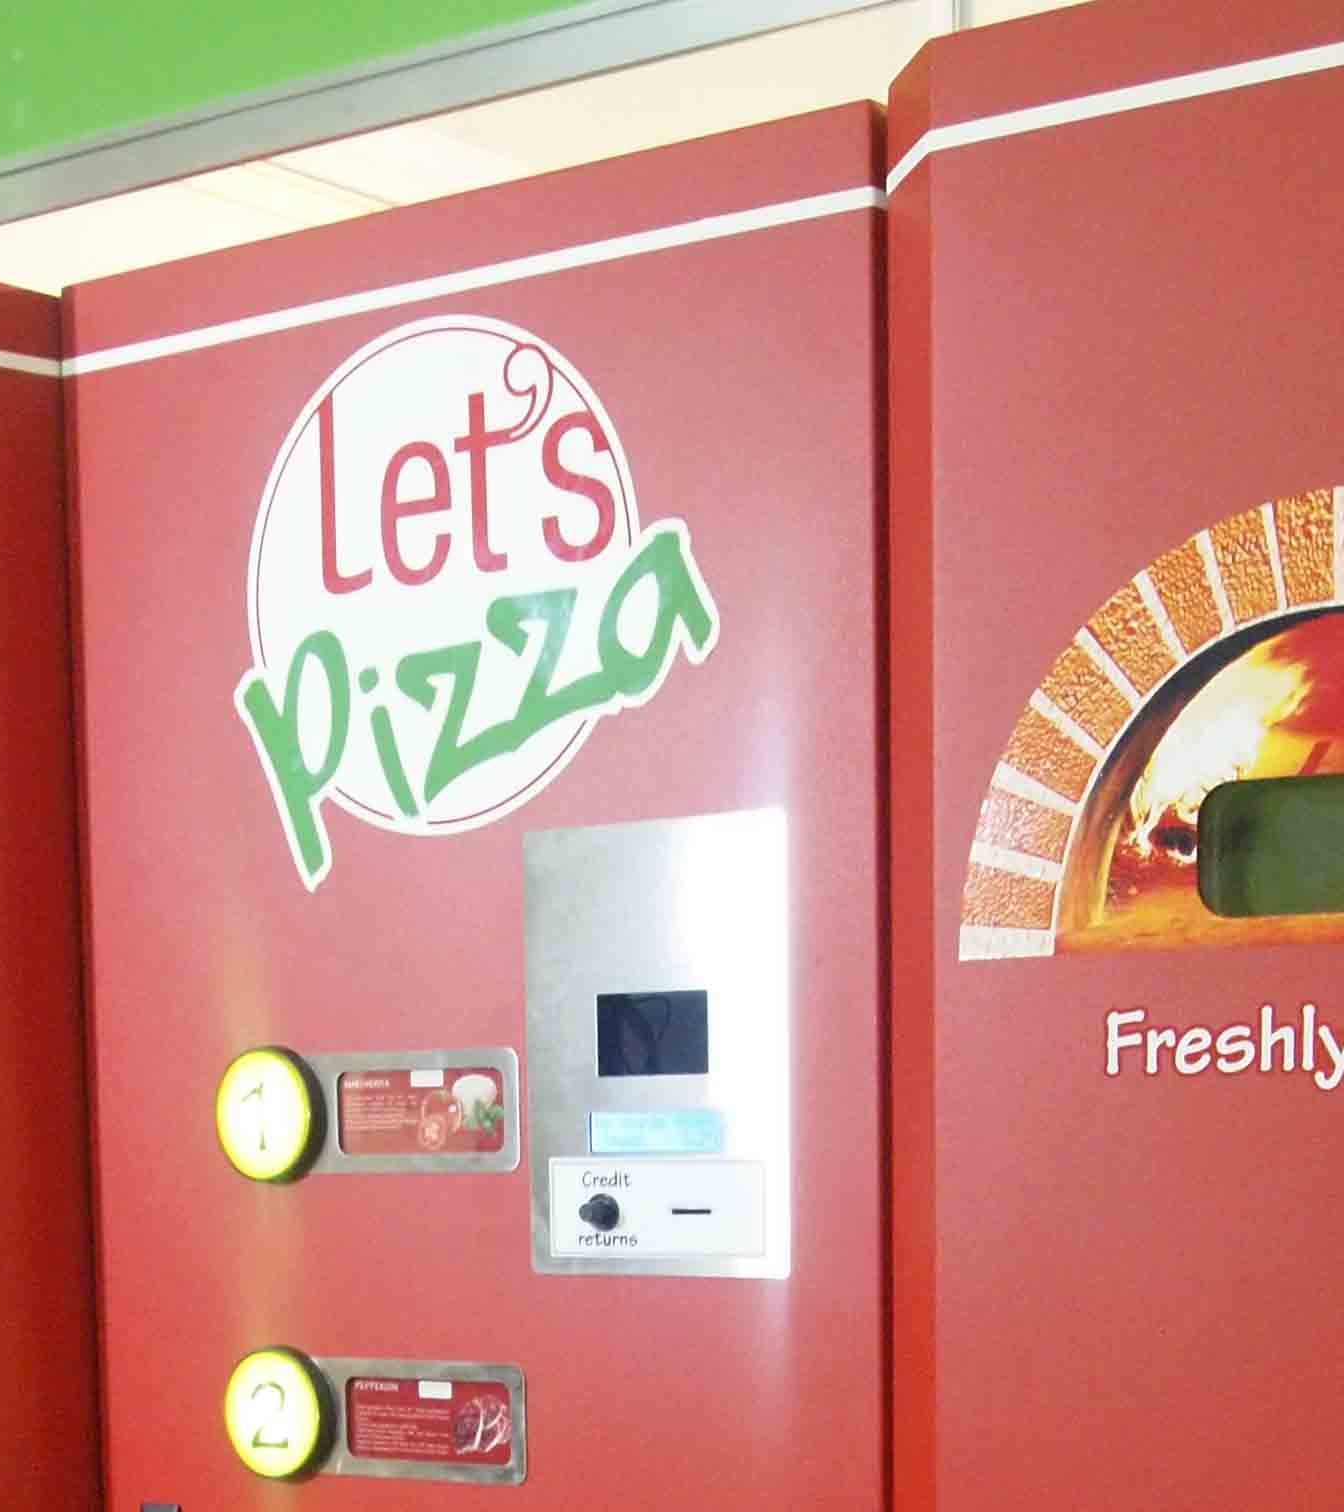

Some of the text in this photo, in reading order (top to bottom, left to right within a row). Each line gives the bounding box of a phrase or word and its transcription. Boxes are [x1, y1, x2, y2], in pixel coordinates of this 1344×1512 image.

[581, 1170, 631, 1189] Credit
[577, 1230, 638, 1248] returns
[250, 1380, 289, 1449] 2
